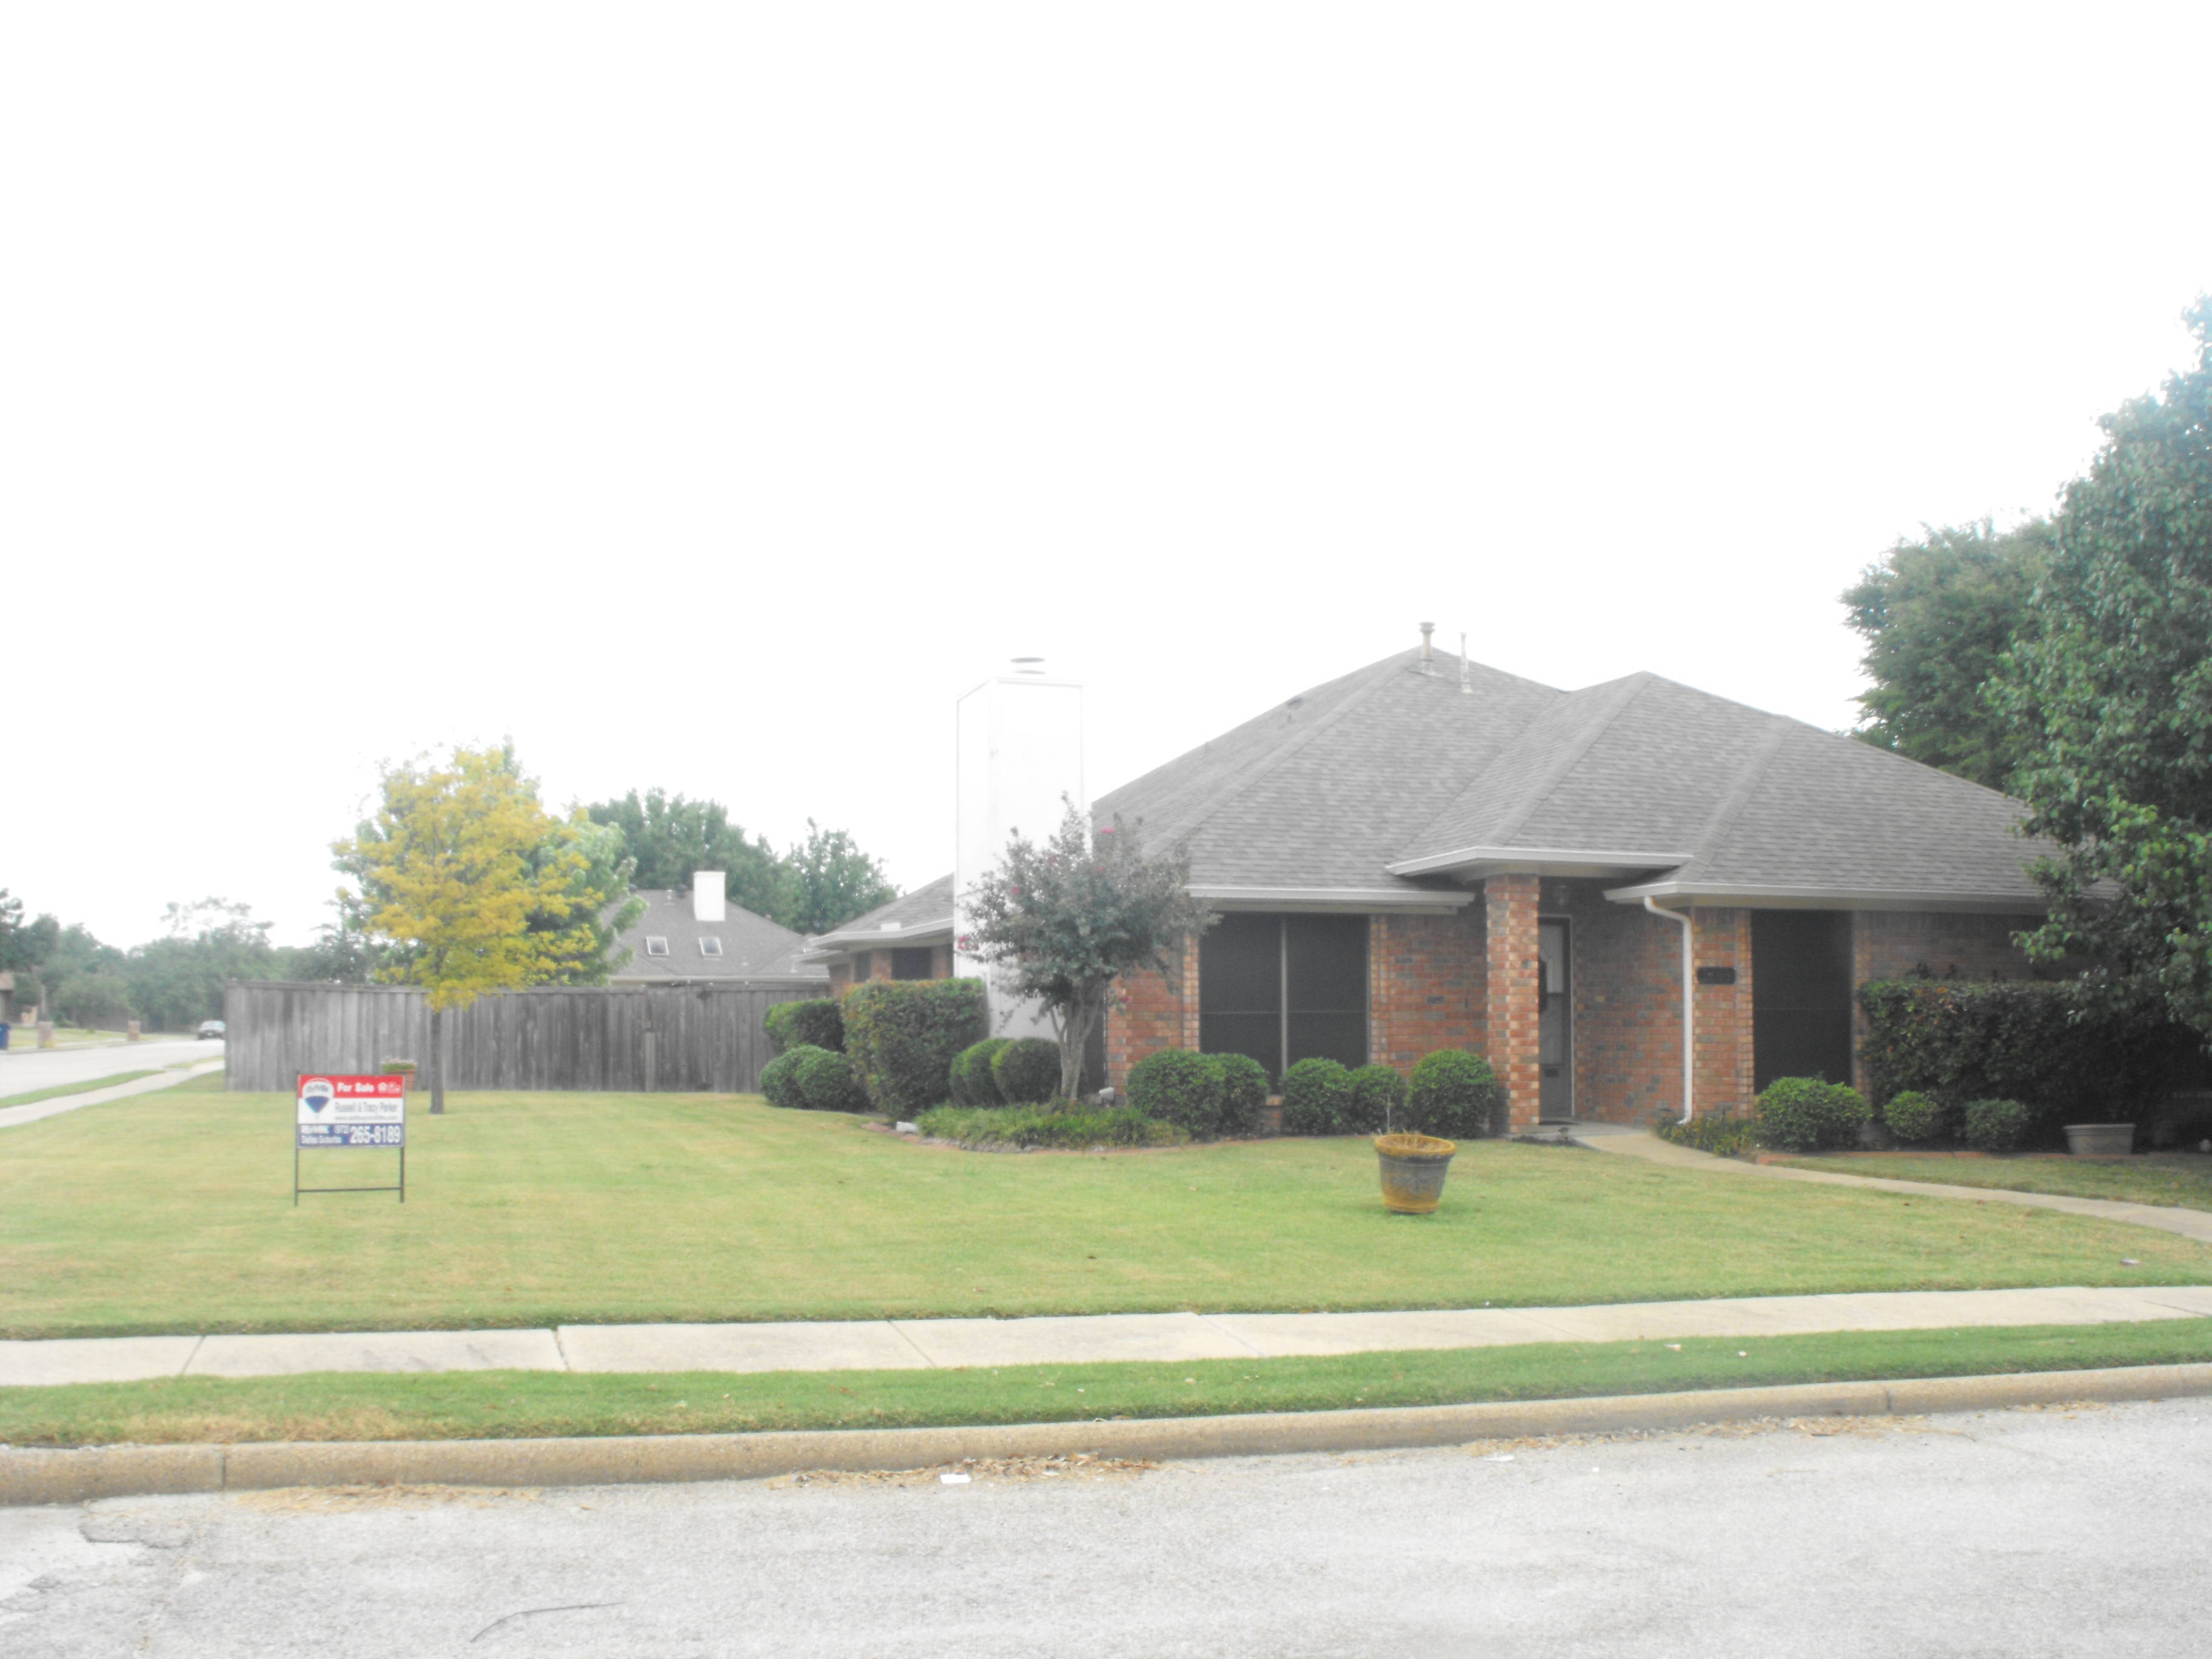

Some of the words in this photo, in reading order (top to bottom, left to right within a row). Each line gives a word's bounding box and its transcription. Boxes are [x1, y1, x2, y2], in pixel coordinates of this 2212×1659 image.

[338, 1082, 352, 1092] For
[355, 1082, 374, 1092] Sale
[350, 1125, 401, 1144] 265-8189
